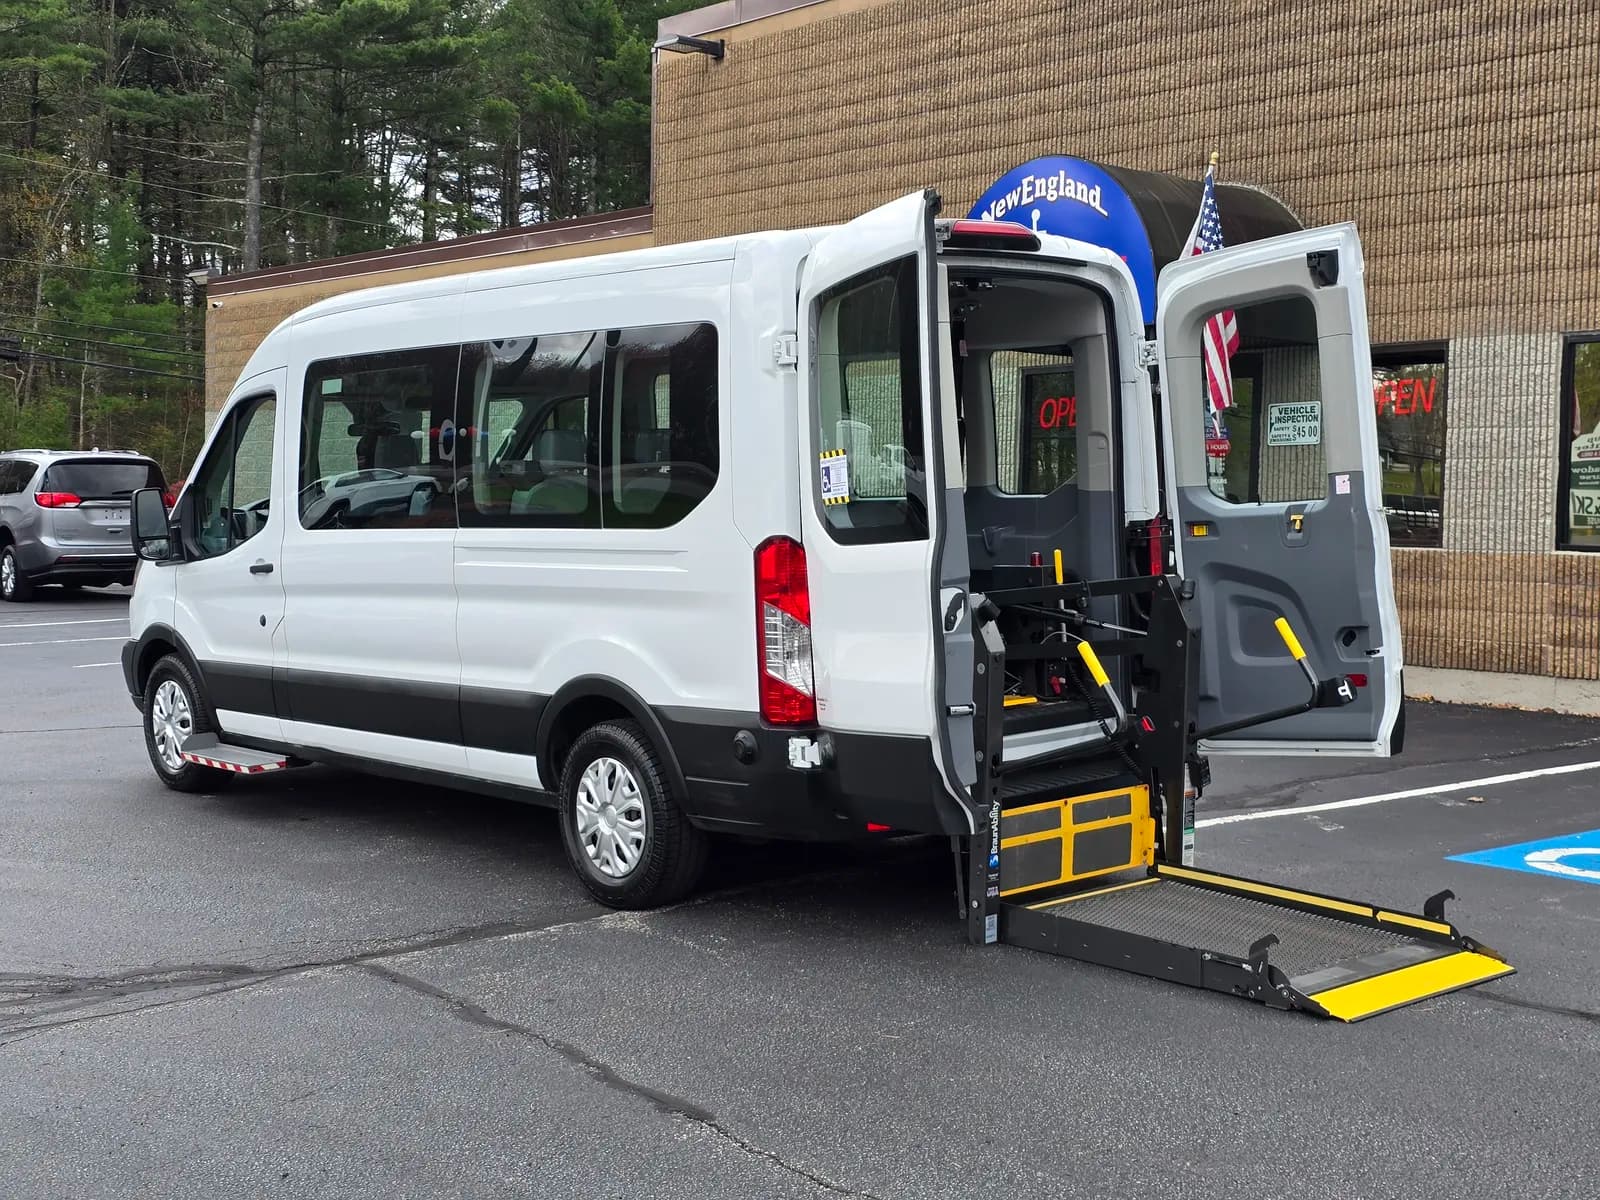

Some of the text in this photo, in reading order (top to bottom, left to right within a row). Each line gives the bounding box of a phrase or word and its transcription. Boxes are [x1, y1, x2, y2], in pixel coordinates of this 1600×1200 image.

[1278, 406, 1316, 415] VEHICLE
[1374, 377, 1436, 415] PEN
[1040, 398, 1077, 428] OPE
[1275, 415, 1319, 424] INSPECTION
[989, 801, 1000, 854] BraunAbility
